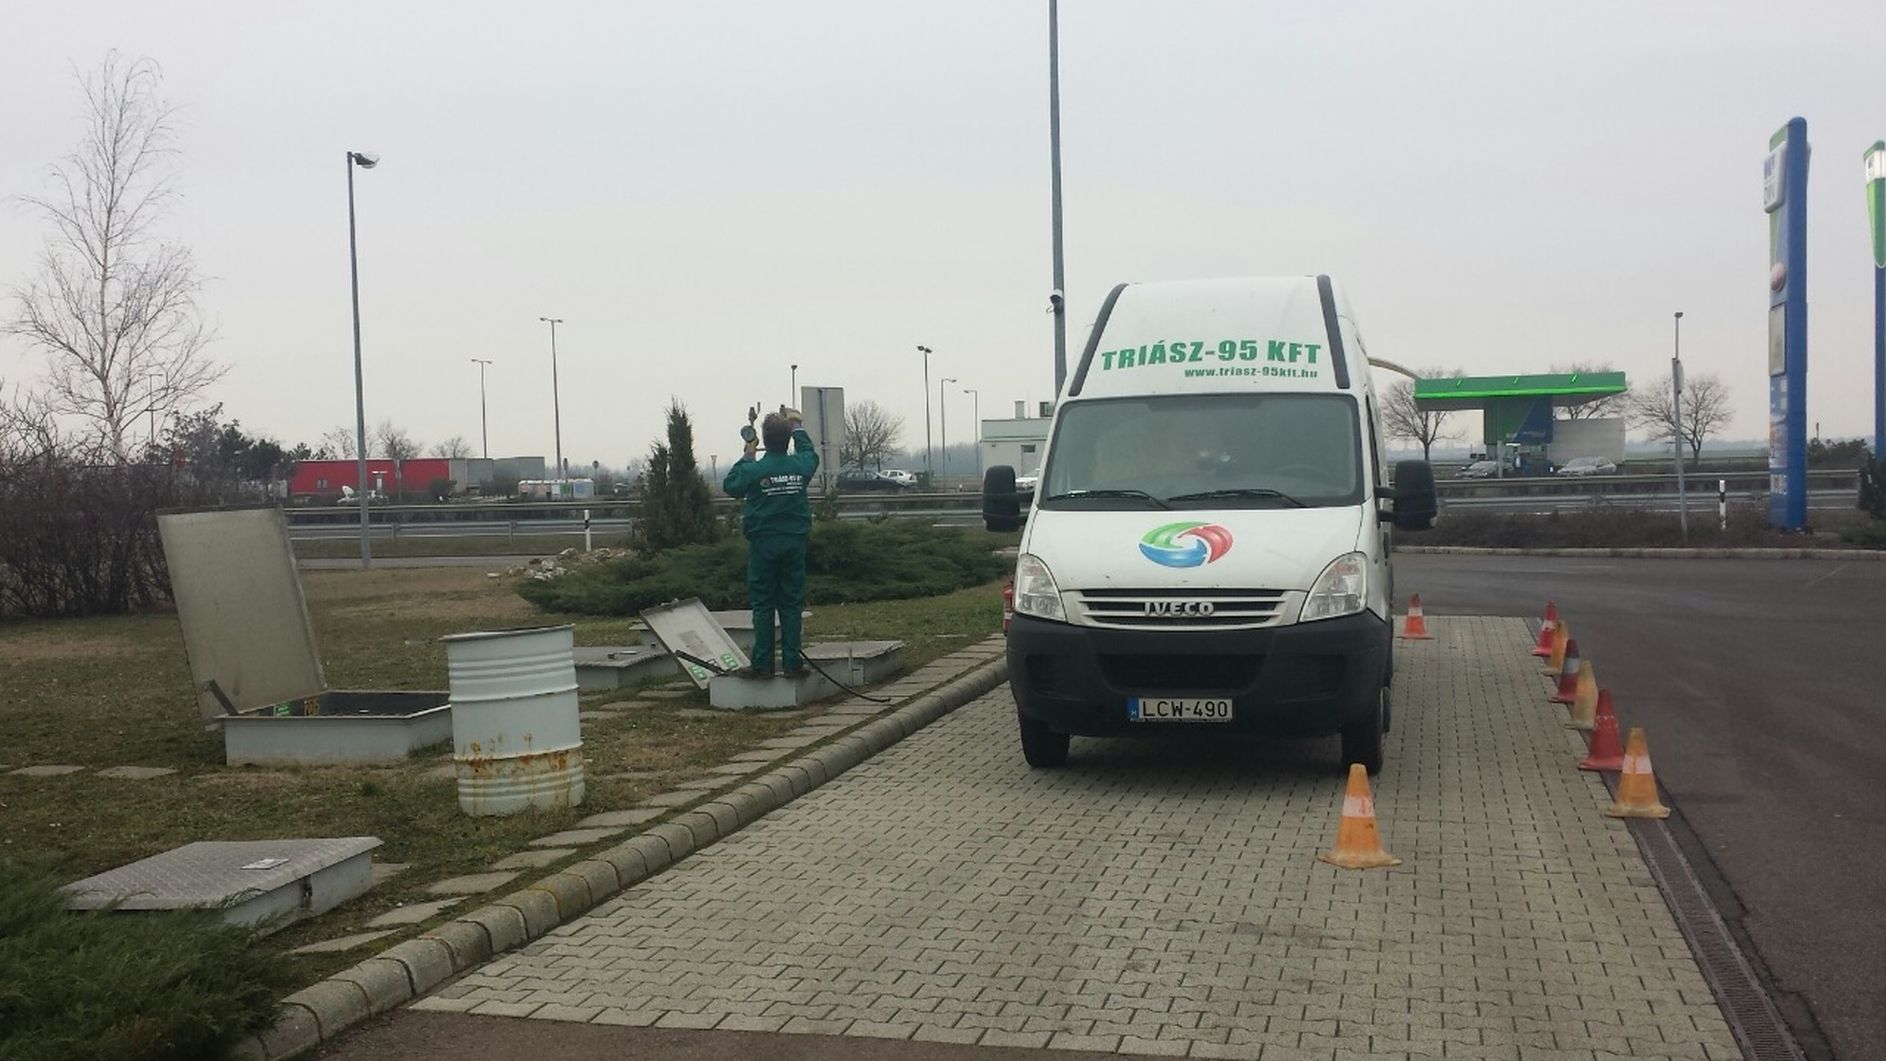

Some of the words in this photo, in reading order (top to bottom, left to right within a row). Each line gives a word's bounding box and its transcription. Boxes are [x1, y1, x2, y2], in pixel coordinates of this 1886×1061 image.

[1101, 340, 1257, 371] TRIÁSZ-95
[1267, 340, 1321, 364] KFT
[1184, 366, 1318, 378] www.triasz-95kft.hu
[1144, 601, 1214, 617] IVECO
[1142, 700, 1228, 717] LCW-490
